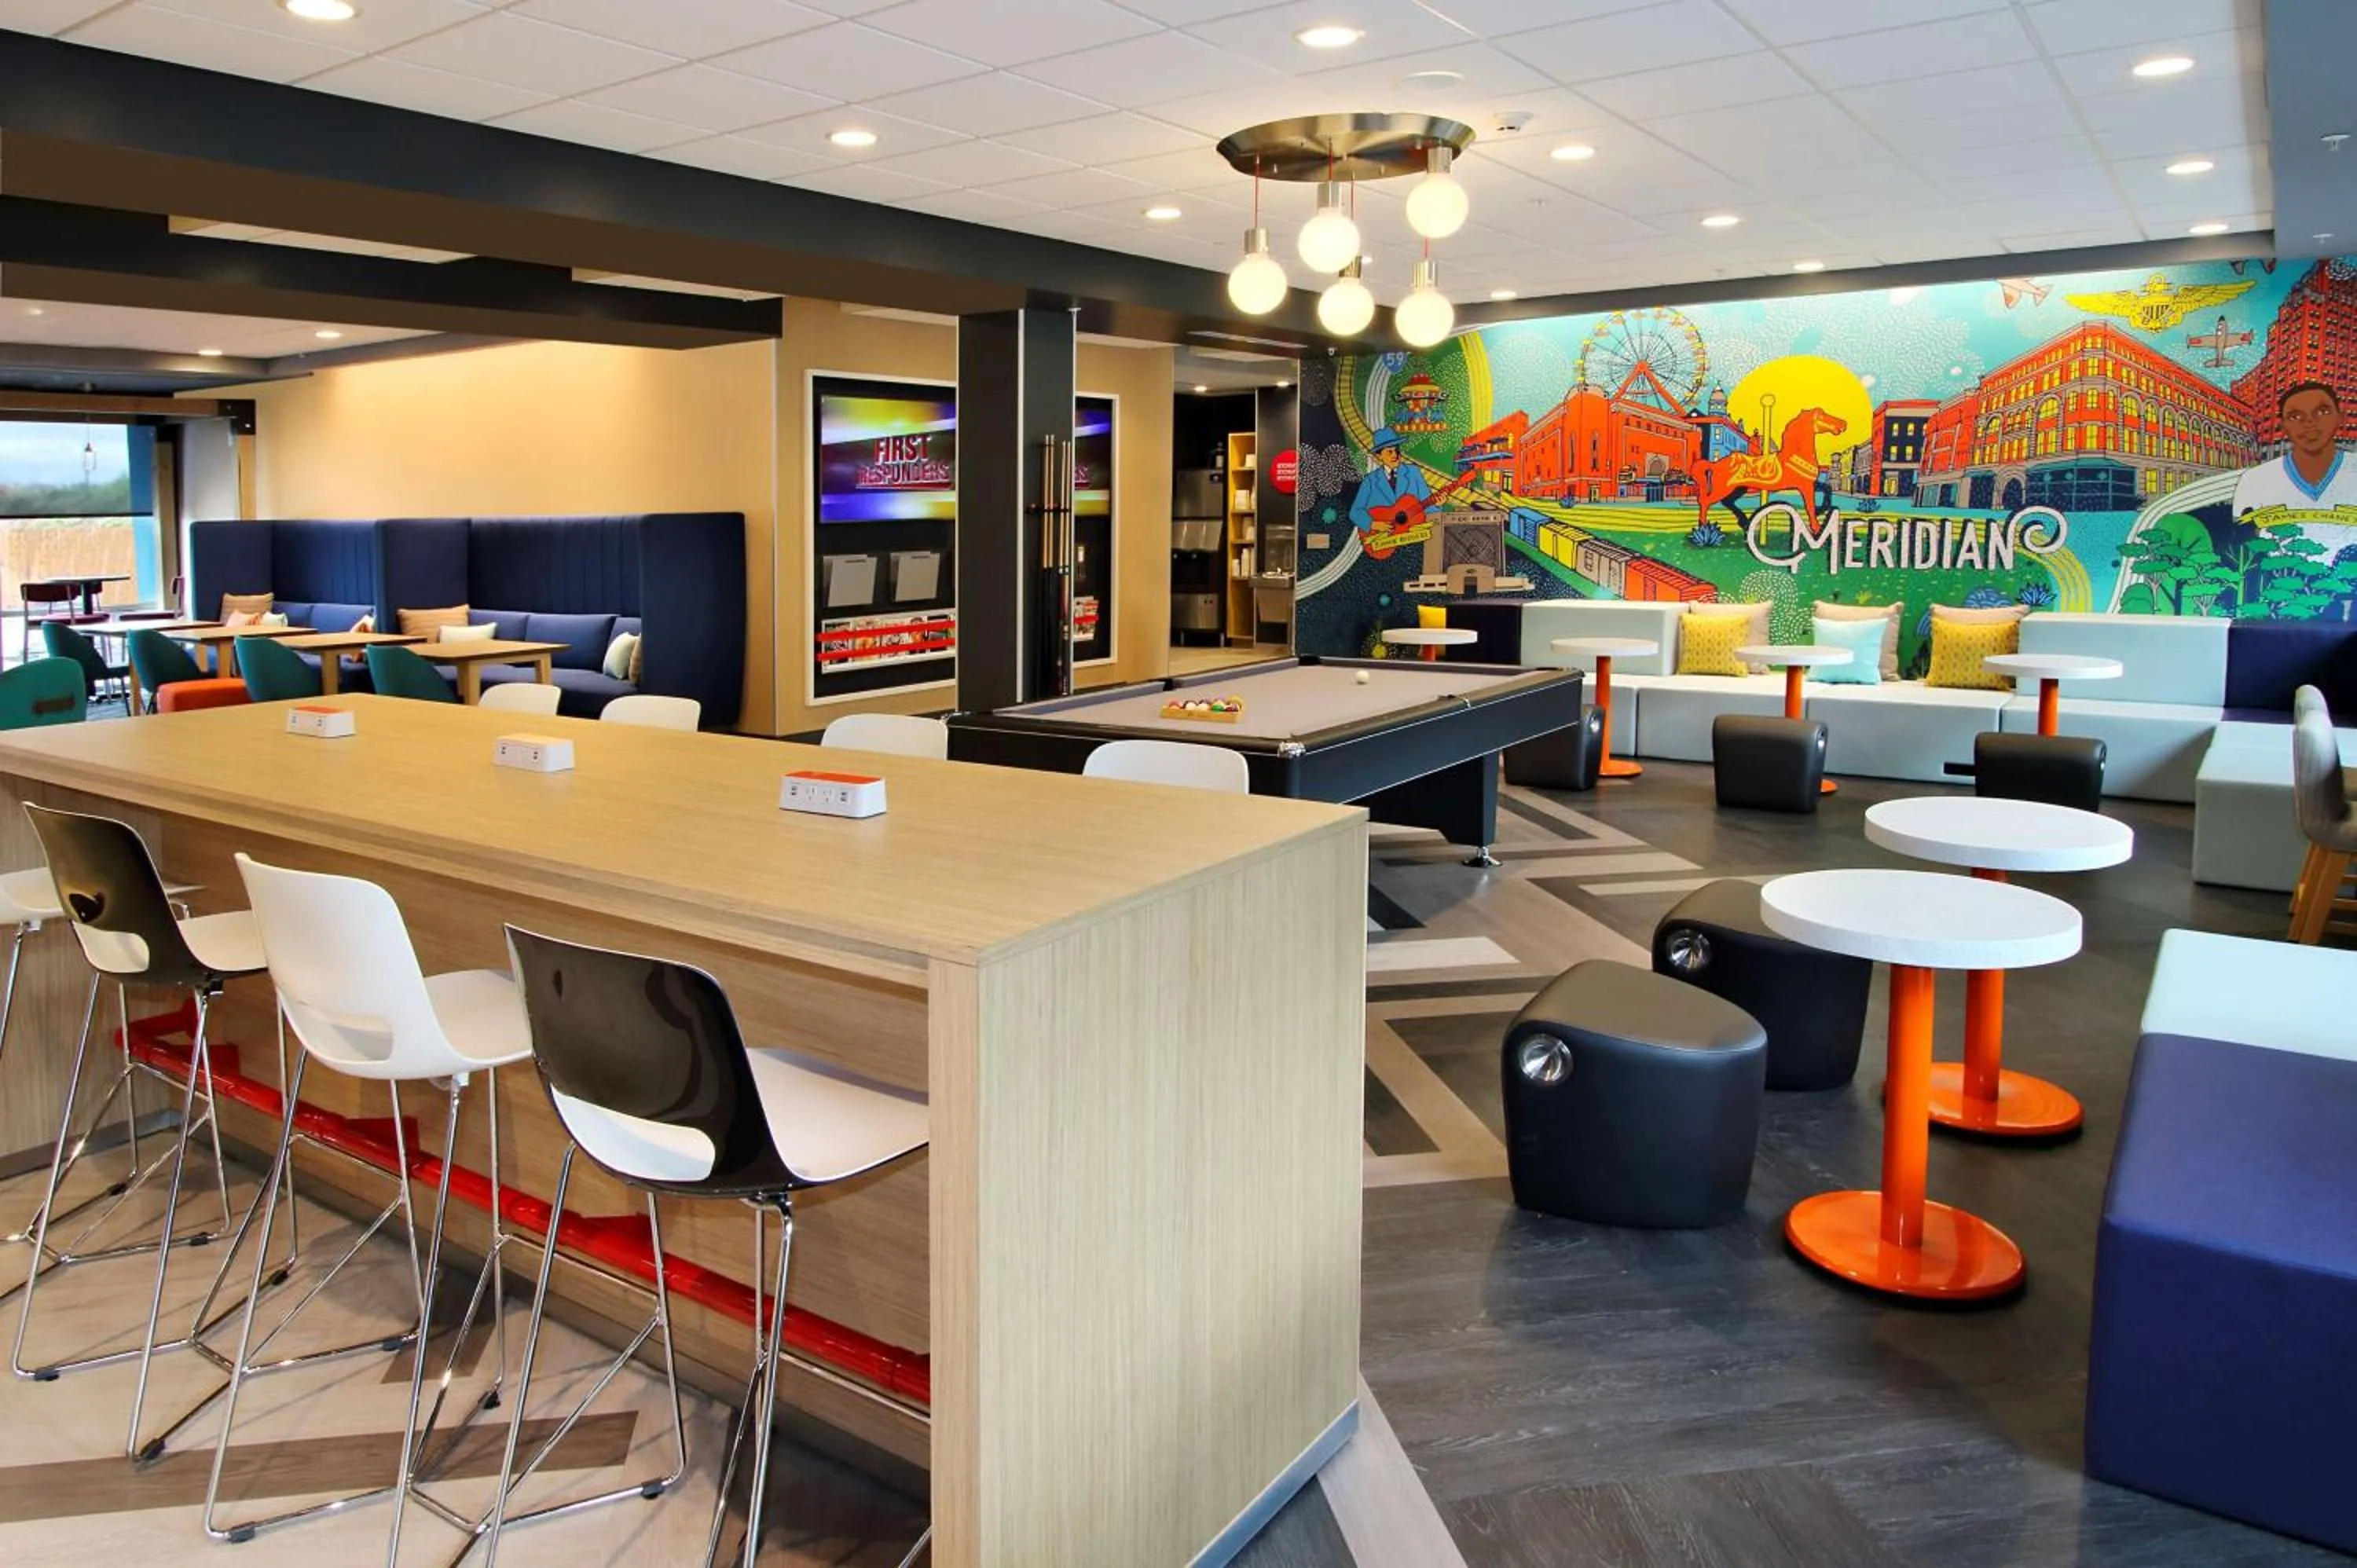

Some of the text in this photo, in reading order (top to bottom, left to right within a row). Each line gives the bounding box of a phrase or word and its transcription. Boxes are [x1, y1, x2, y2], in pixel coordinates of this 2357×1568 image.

[1386, 351, 1404, 366] 59
[874, 434, 933, 464] FIRST
[856, 460, 950, 485] RESPONDERS
[1747, 503, 2069, 575] MERIDIAN
